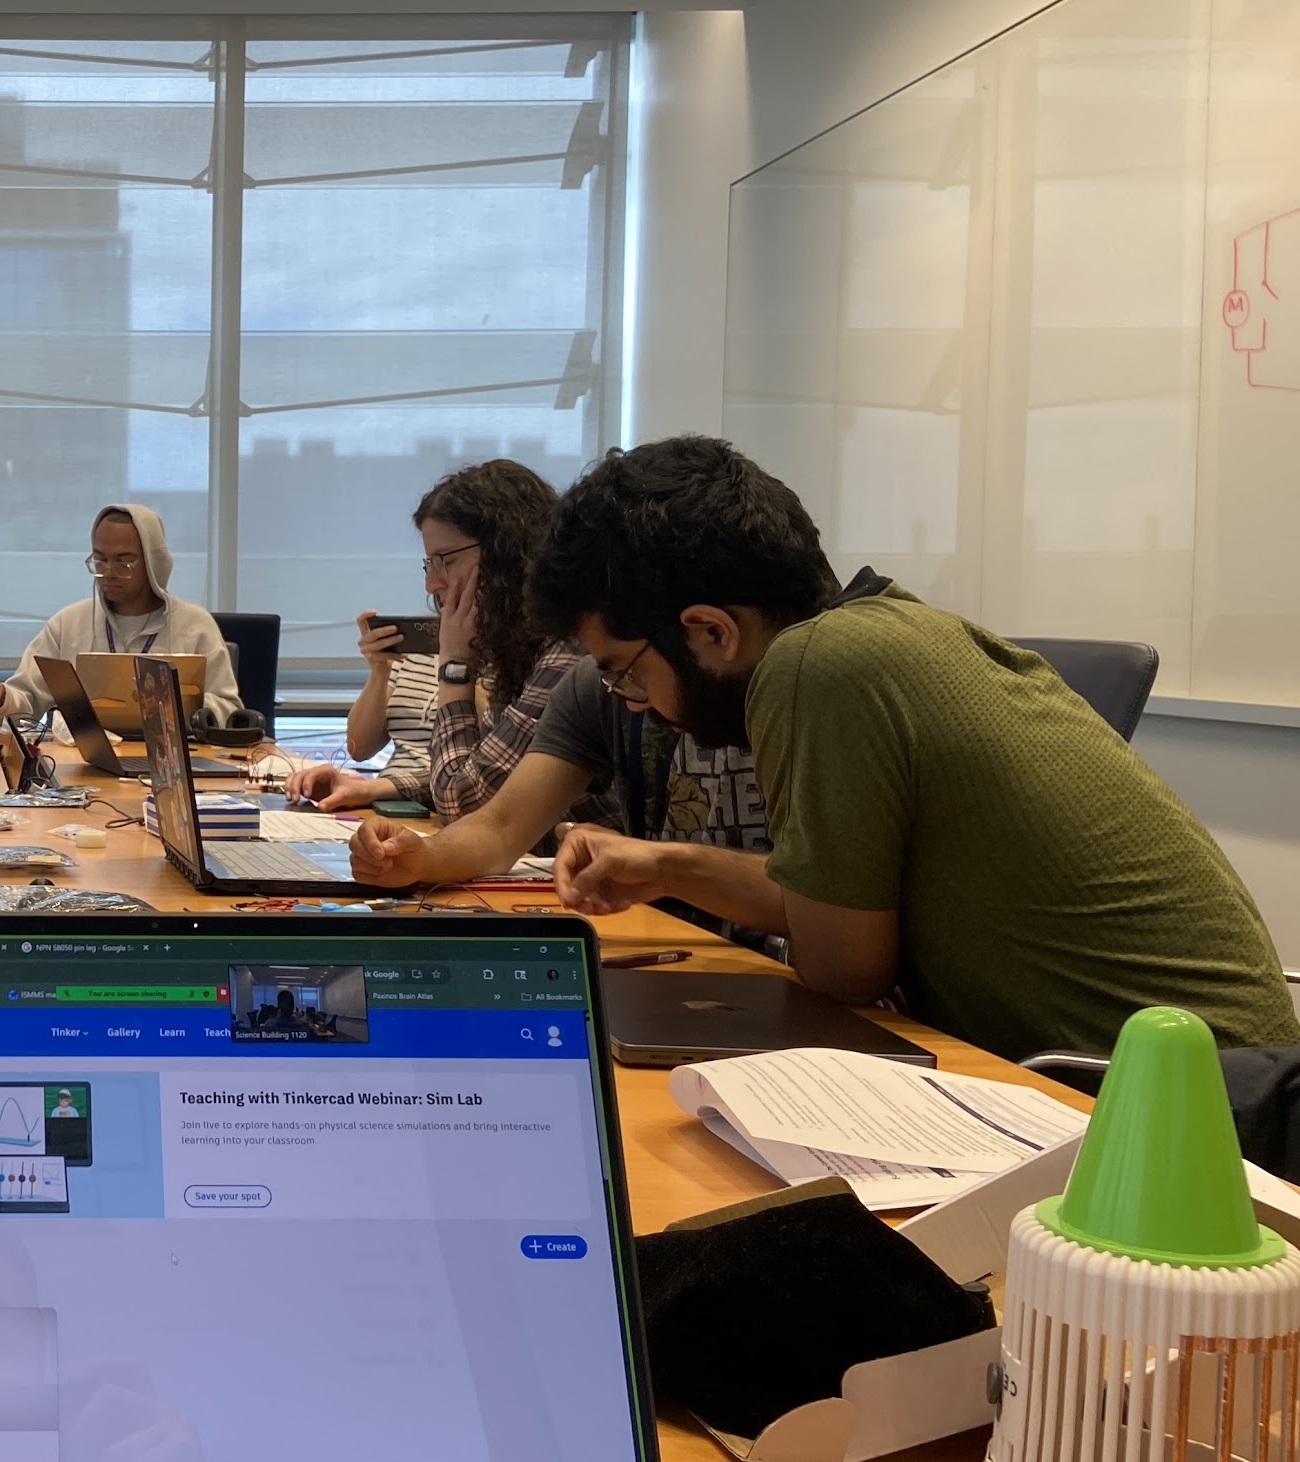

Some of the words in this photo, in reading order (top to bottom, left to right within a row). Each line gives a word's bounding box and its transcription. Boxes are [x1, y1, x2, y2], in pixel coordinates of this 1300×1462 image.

[1228, 296, 1244, 313] M
[74, 944, 86, 953] pin
[87, 944, 97, 953] leg
[102, 944, 126, 953] Google
[372, 970, 399, 980] Google
[21, 990, 45, 999] ISMMS
[88, 990, 102, 998] You
[141, 990, 167, 999] sharing
[373, 992, 397, 1000] Paxinos
[398, 992, 415, 1000] Brain
[535, 993, 545, 1001] All
[546, 993, 583, 1001] Bookmarks
[50, 1027, 80, 1037] Tinker
[107, 1027, 141, 1039] Gallery
[159, 1027, 186, 1037] Learn
[204, 1027, 231, 1037] Teach
[235, 1030, 261, 1040] Science
[261, 1030, 290, 1041] Building
[291, 1030, 308, 1040] 1120
[179, 1091, 245, 1107] Teaching
[247, 1091, 280, 1105] with
[282, 1091, 355, 1106] Tinkercad
[357, 1092, 423, 1106] Webinar:
[426, 1092, 454, 1106] Sim
[457, 1092, 483, 1106] Lab
[180, 1120, 201, 1130] Join
[203, 1120, 220, 1130] live
[222, 1121, 232, 1130] to
[234, 1120, 269, 1133] explore
[271, 1120, 316, 1131] hands-on
[318, 1120, 357, 1133] physical
[359, 1121, 394, 1131] science
[396, 1121, 451, 1132] simulations
[453, 1121, 471, 1132] and
[473, 1121, 498, 1134] bring
[500, 1121, 551, 1132] interactive
[181, 1135, 220, 1148] learning
[222, 1135, 241, 1146] into
[243, 1137, 265, 1148] your
[194, 1191, 217, 1201] Save
[219, 1193, 239, 1204] your
[241, 1191, 261, 1204] spot
[546, 1241, 577, 1252] Create
